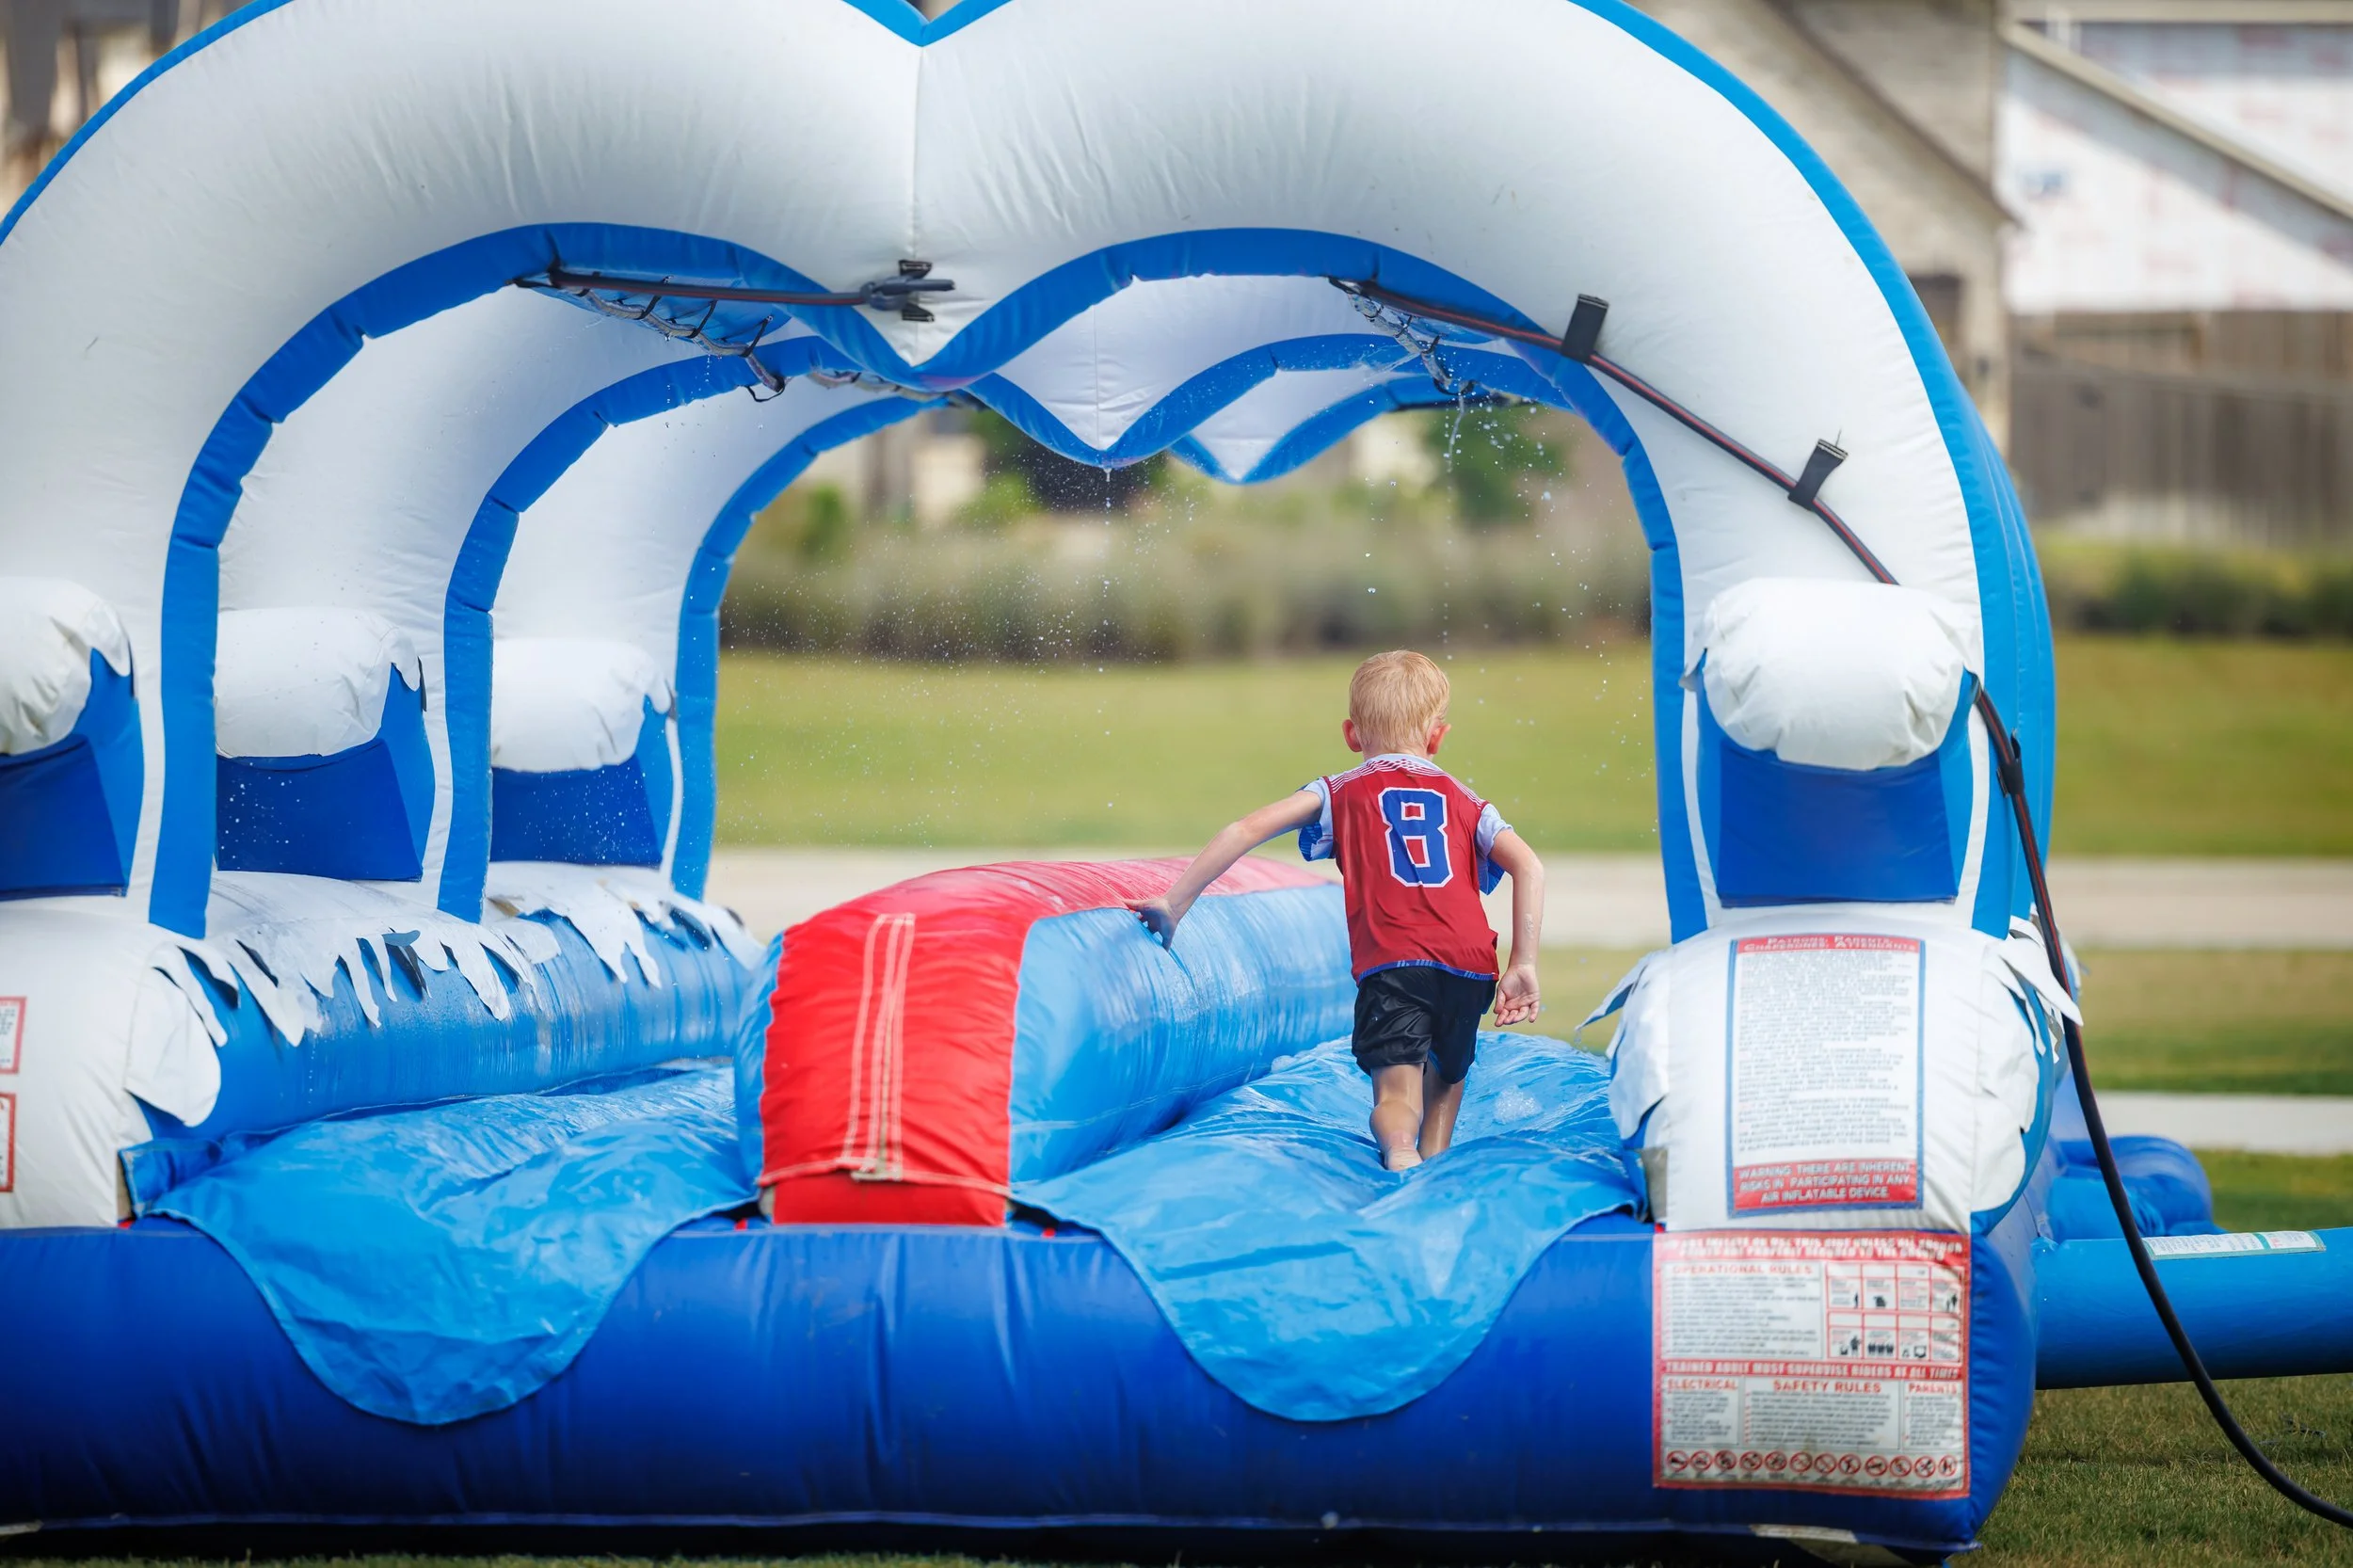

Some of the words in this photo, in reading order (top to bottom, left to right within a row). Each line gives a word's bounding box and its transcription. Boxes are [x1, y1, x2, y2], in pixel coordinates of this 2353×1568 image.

[1378, 787, 1453, 888] 8
[1797, 1163, 1830, 1175] THERE
[1834, 1162, 1855, 1173] ARE
[1859, 1161, 1912, 1174] INHERENT
[1739, 1179, 1770, 1192] RISKS
[1773, 1178, 1785, 1189] IN
[1790, 1175, 1869, 1188] PARTICIPATING
[1873, 1174, 1883, 1184] IN
[1886, 1174, 1911, 1185] ANY
[1760, 1192, 1779, 1203] AIR
[1782, 1188, 1846, 1202] INFLATABLE
[1672, 1265, 1763, 1274] OPERATIONAL
[1769, 1265, 1813, 1274] RULES
[1668, 1378, 1737, 1390] ELECTRICAL
[1773, 1380, 1828, 1391] SAFETY
[1834, 1382, 1881, 1393] RULES
[1908, 1383, 1958, 1394] PARENTS
